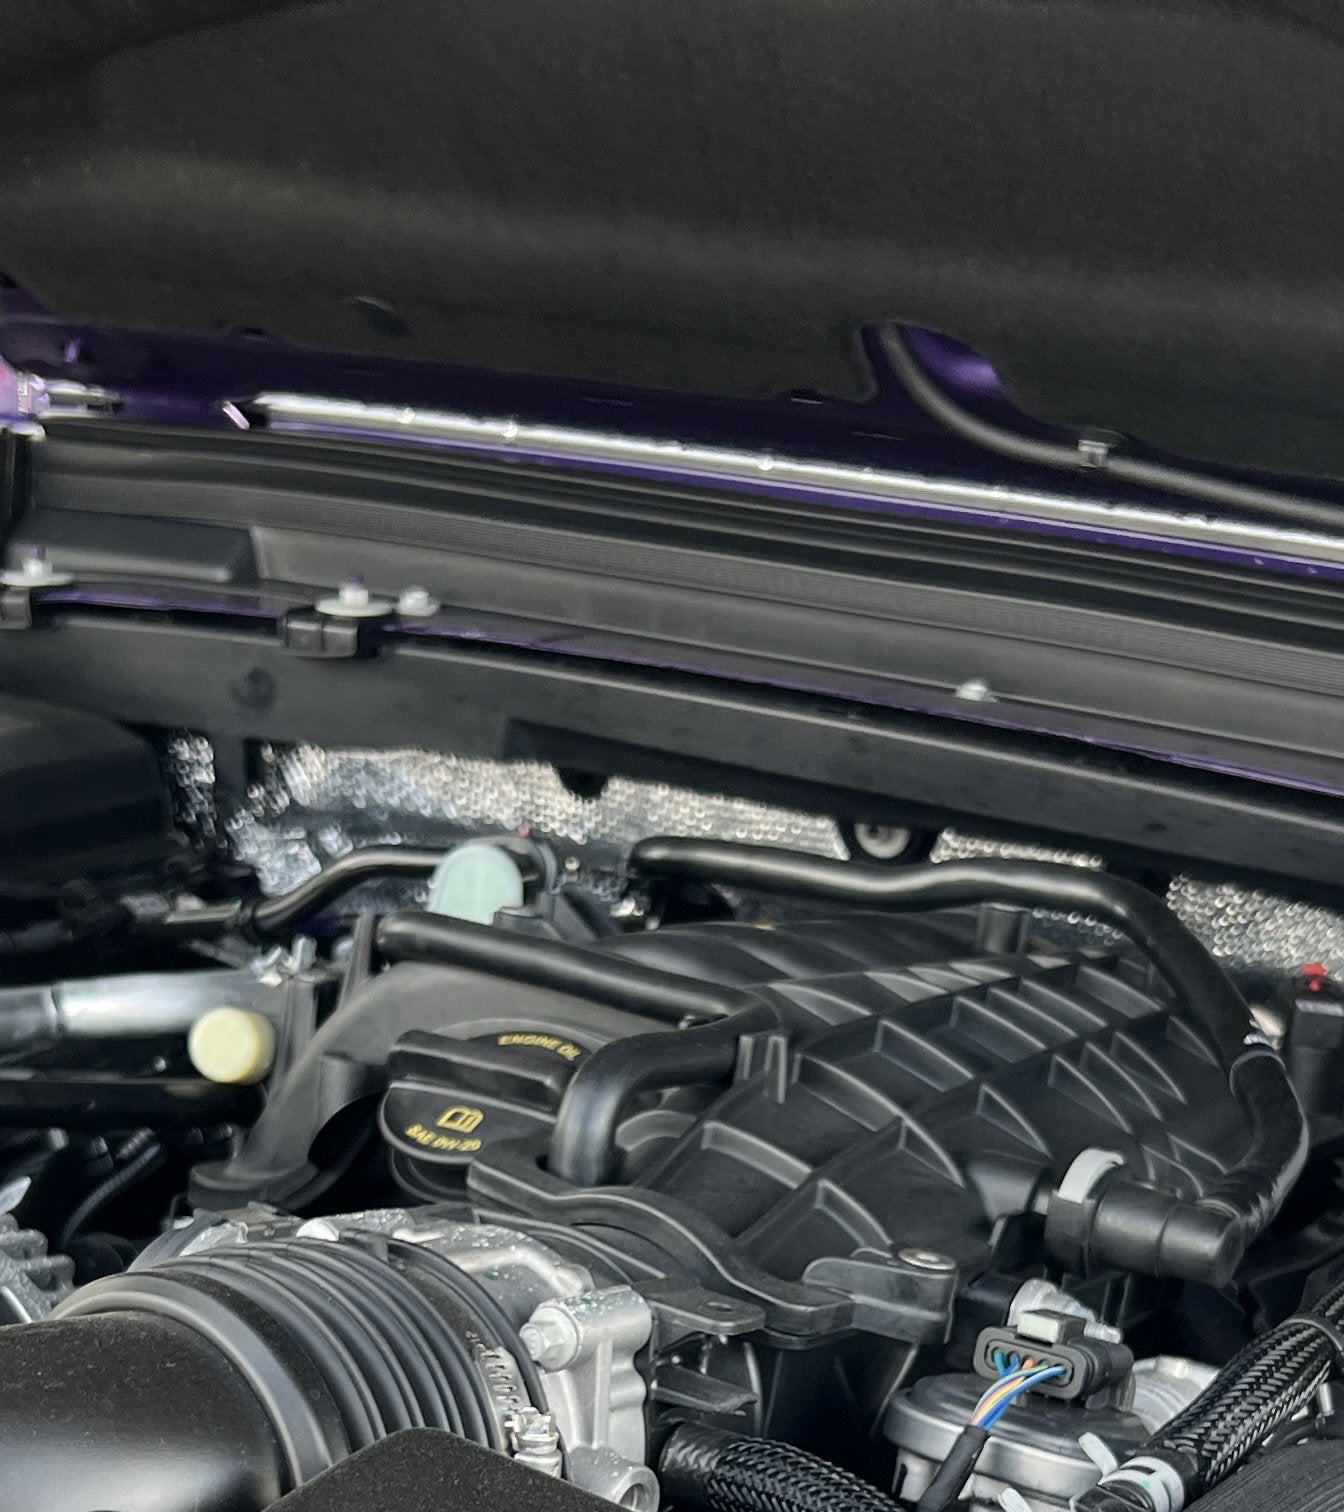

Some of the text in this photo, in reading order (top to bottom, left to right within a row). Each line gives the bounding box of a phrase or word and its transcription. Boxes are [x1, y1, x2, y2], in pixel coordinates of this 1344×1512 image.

[497, 1033, 582, 1062] ENGINE OIL
[405, 1123, 437, 1146] SAE
